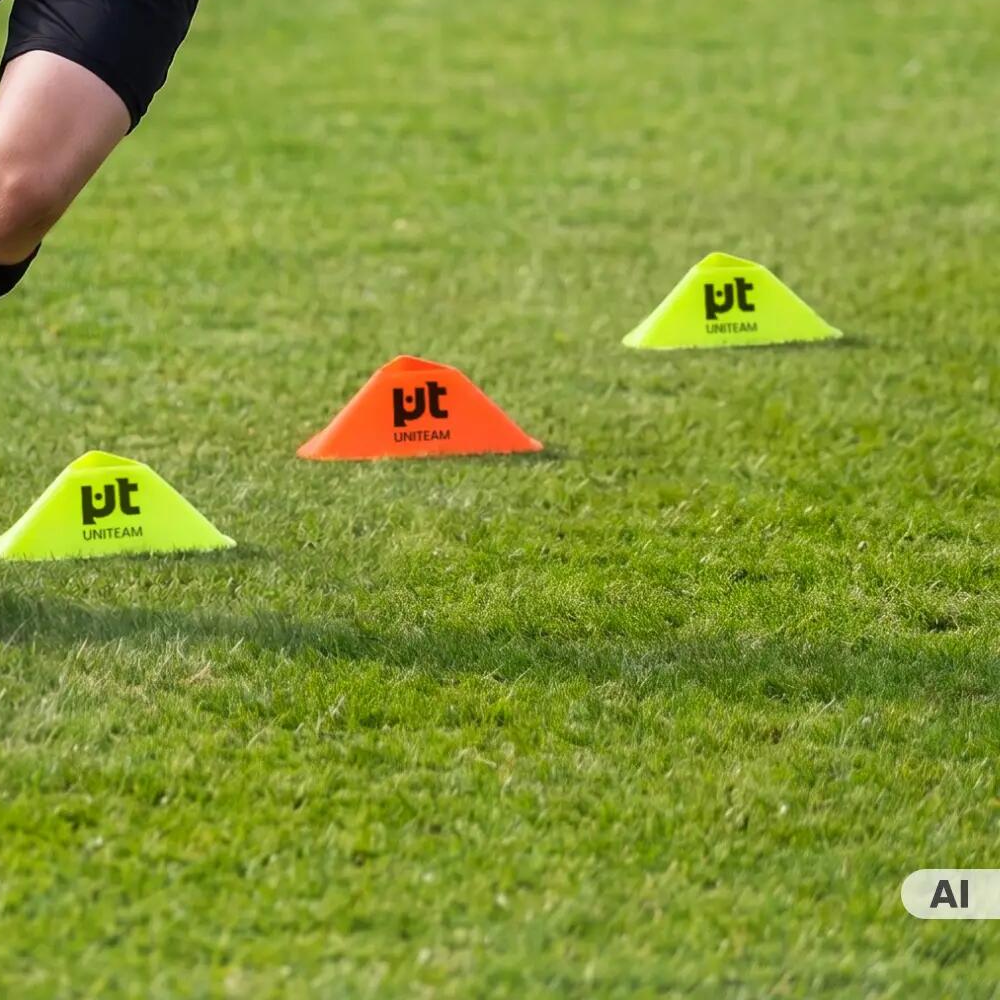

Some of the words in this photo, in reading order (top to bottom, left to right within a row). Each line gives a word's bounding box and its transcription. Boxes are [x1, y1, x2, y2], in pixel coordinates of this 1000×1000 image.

[705, 320, 758, 334] UNITEAM
[393, 428, 451, 443] UNITEAM
[83, 525, 144, 541] UNITEAM
